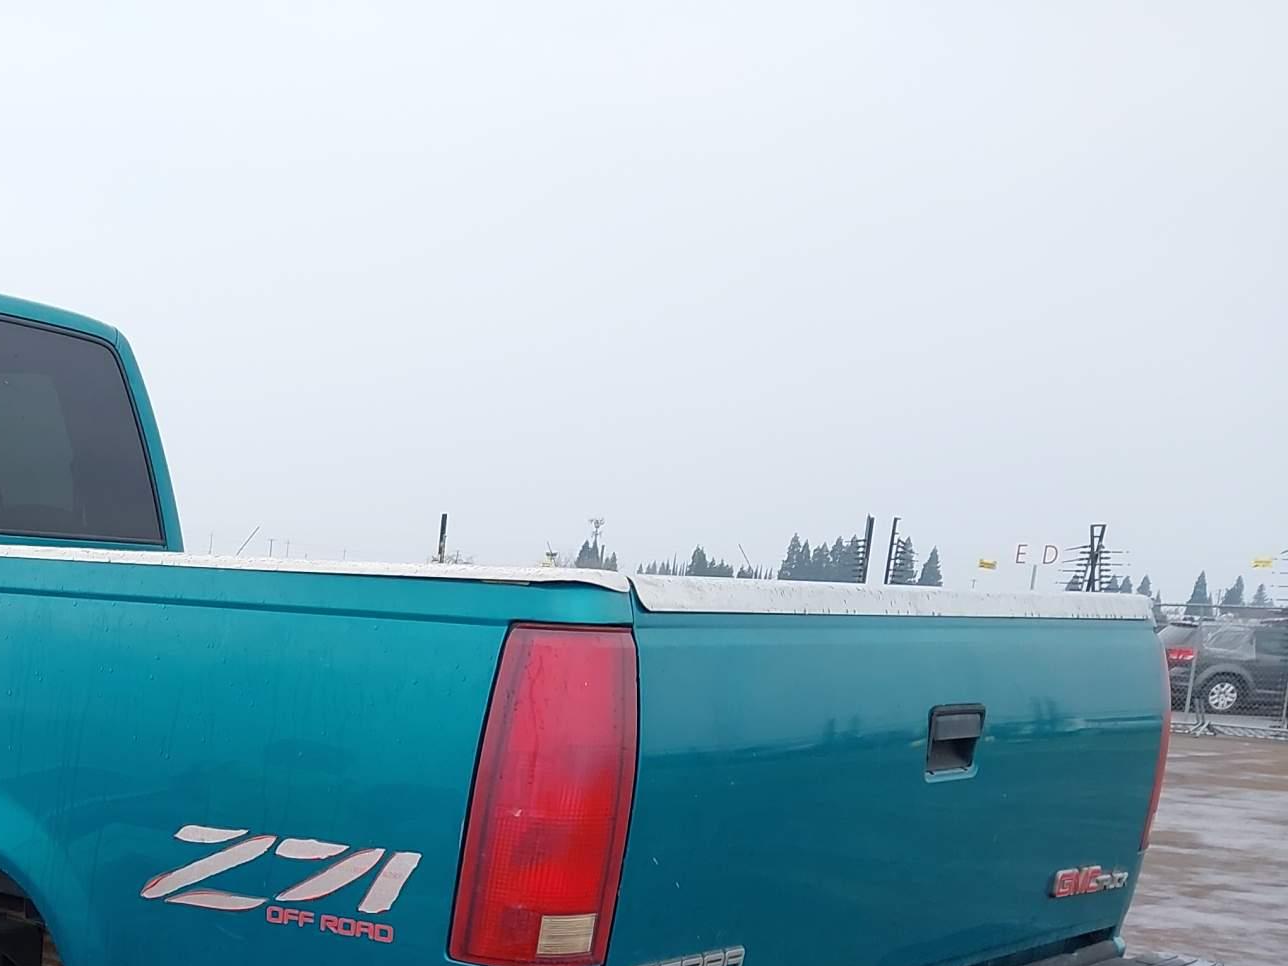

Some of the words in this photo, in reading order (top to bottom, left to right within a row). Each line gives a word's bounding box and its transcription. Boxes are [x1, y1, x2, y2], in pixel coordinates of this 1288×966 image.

[1015, 543, 1028, 564] E
[1042, 544, 1059, 565] D
[140, 824, 423, 914] Z71
[265, 905, 315, 928] OFF
[320, 914, 394, 944] ROAD
